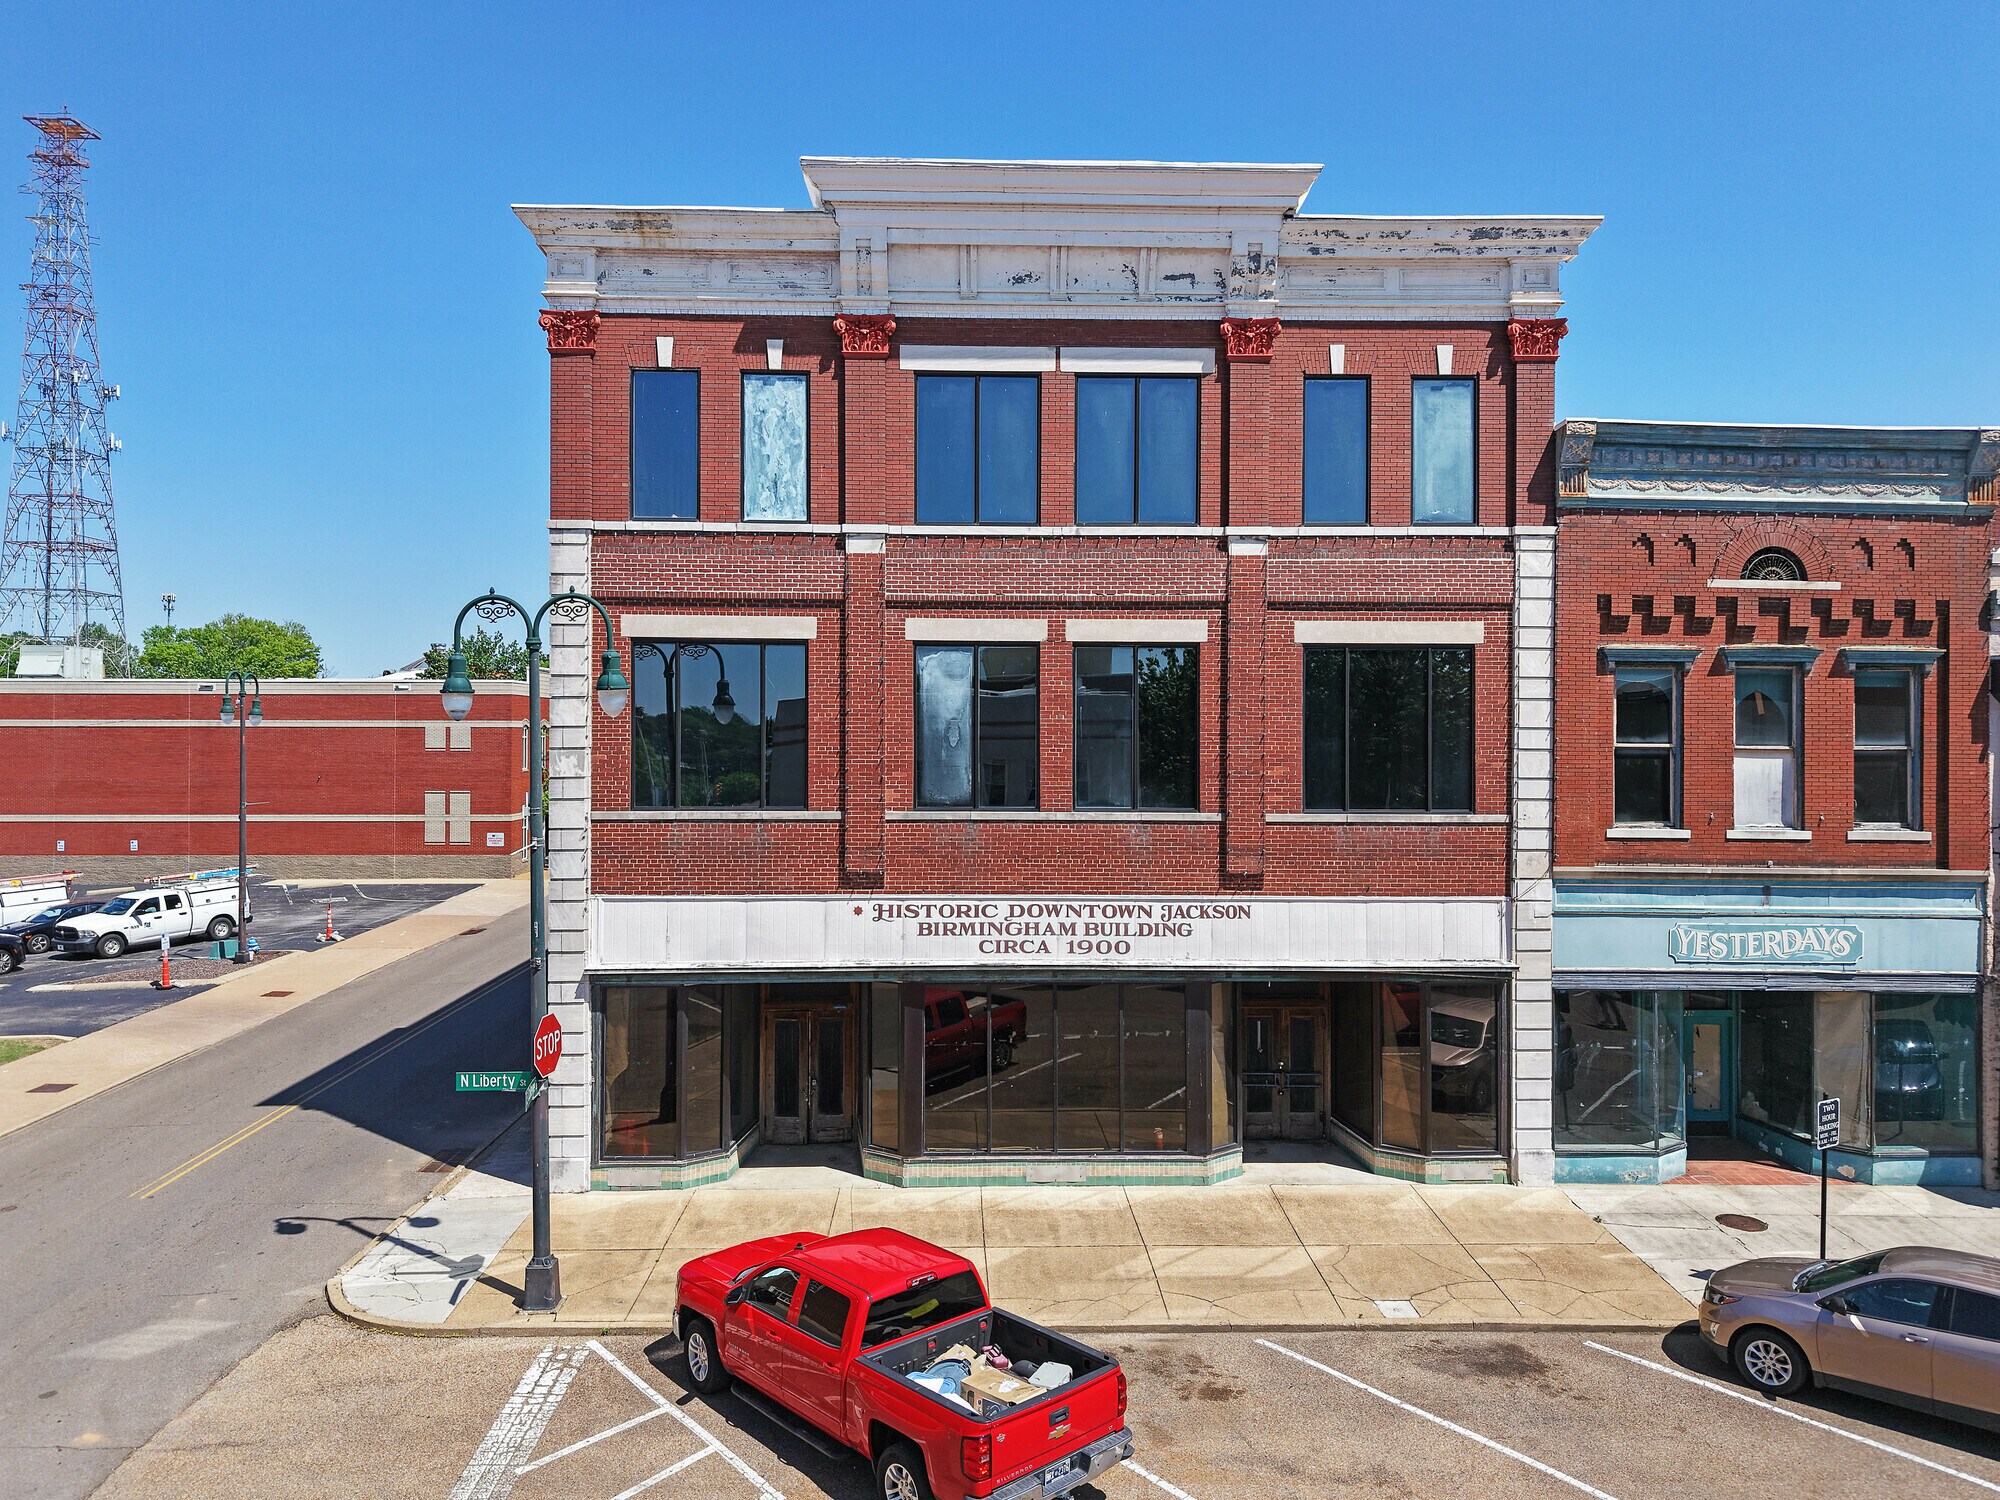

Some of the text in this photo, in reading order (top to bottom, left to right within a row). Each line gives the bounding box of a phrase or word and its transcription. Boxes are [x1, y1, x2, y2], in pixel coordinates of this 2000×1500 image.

[872, 903, 1251, 922] HISTORIC DOWNTOWN JACKSON
[917, 922, 1193, 937] BIRMINGHAM BUILDING
[978, 939, 1131, 955] CIRCA 1900
[1675, 927, 1857, 959] YESTERDAYS
[536, 1029, 561, 1061] STOP
[460, 1074, 469, 1087] N
[472, 1074, 516, 1090] Liberty
[1822, 1103, 1835, 1113] TWO
[1821, 1113, 1837, 1123] HOUR
[1819, 1121, 1839, 1132] PARKING
[996, 1464, 1033, 1484] SILVERADO
